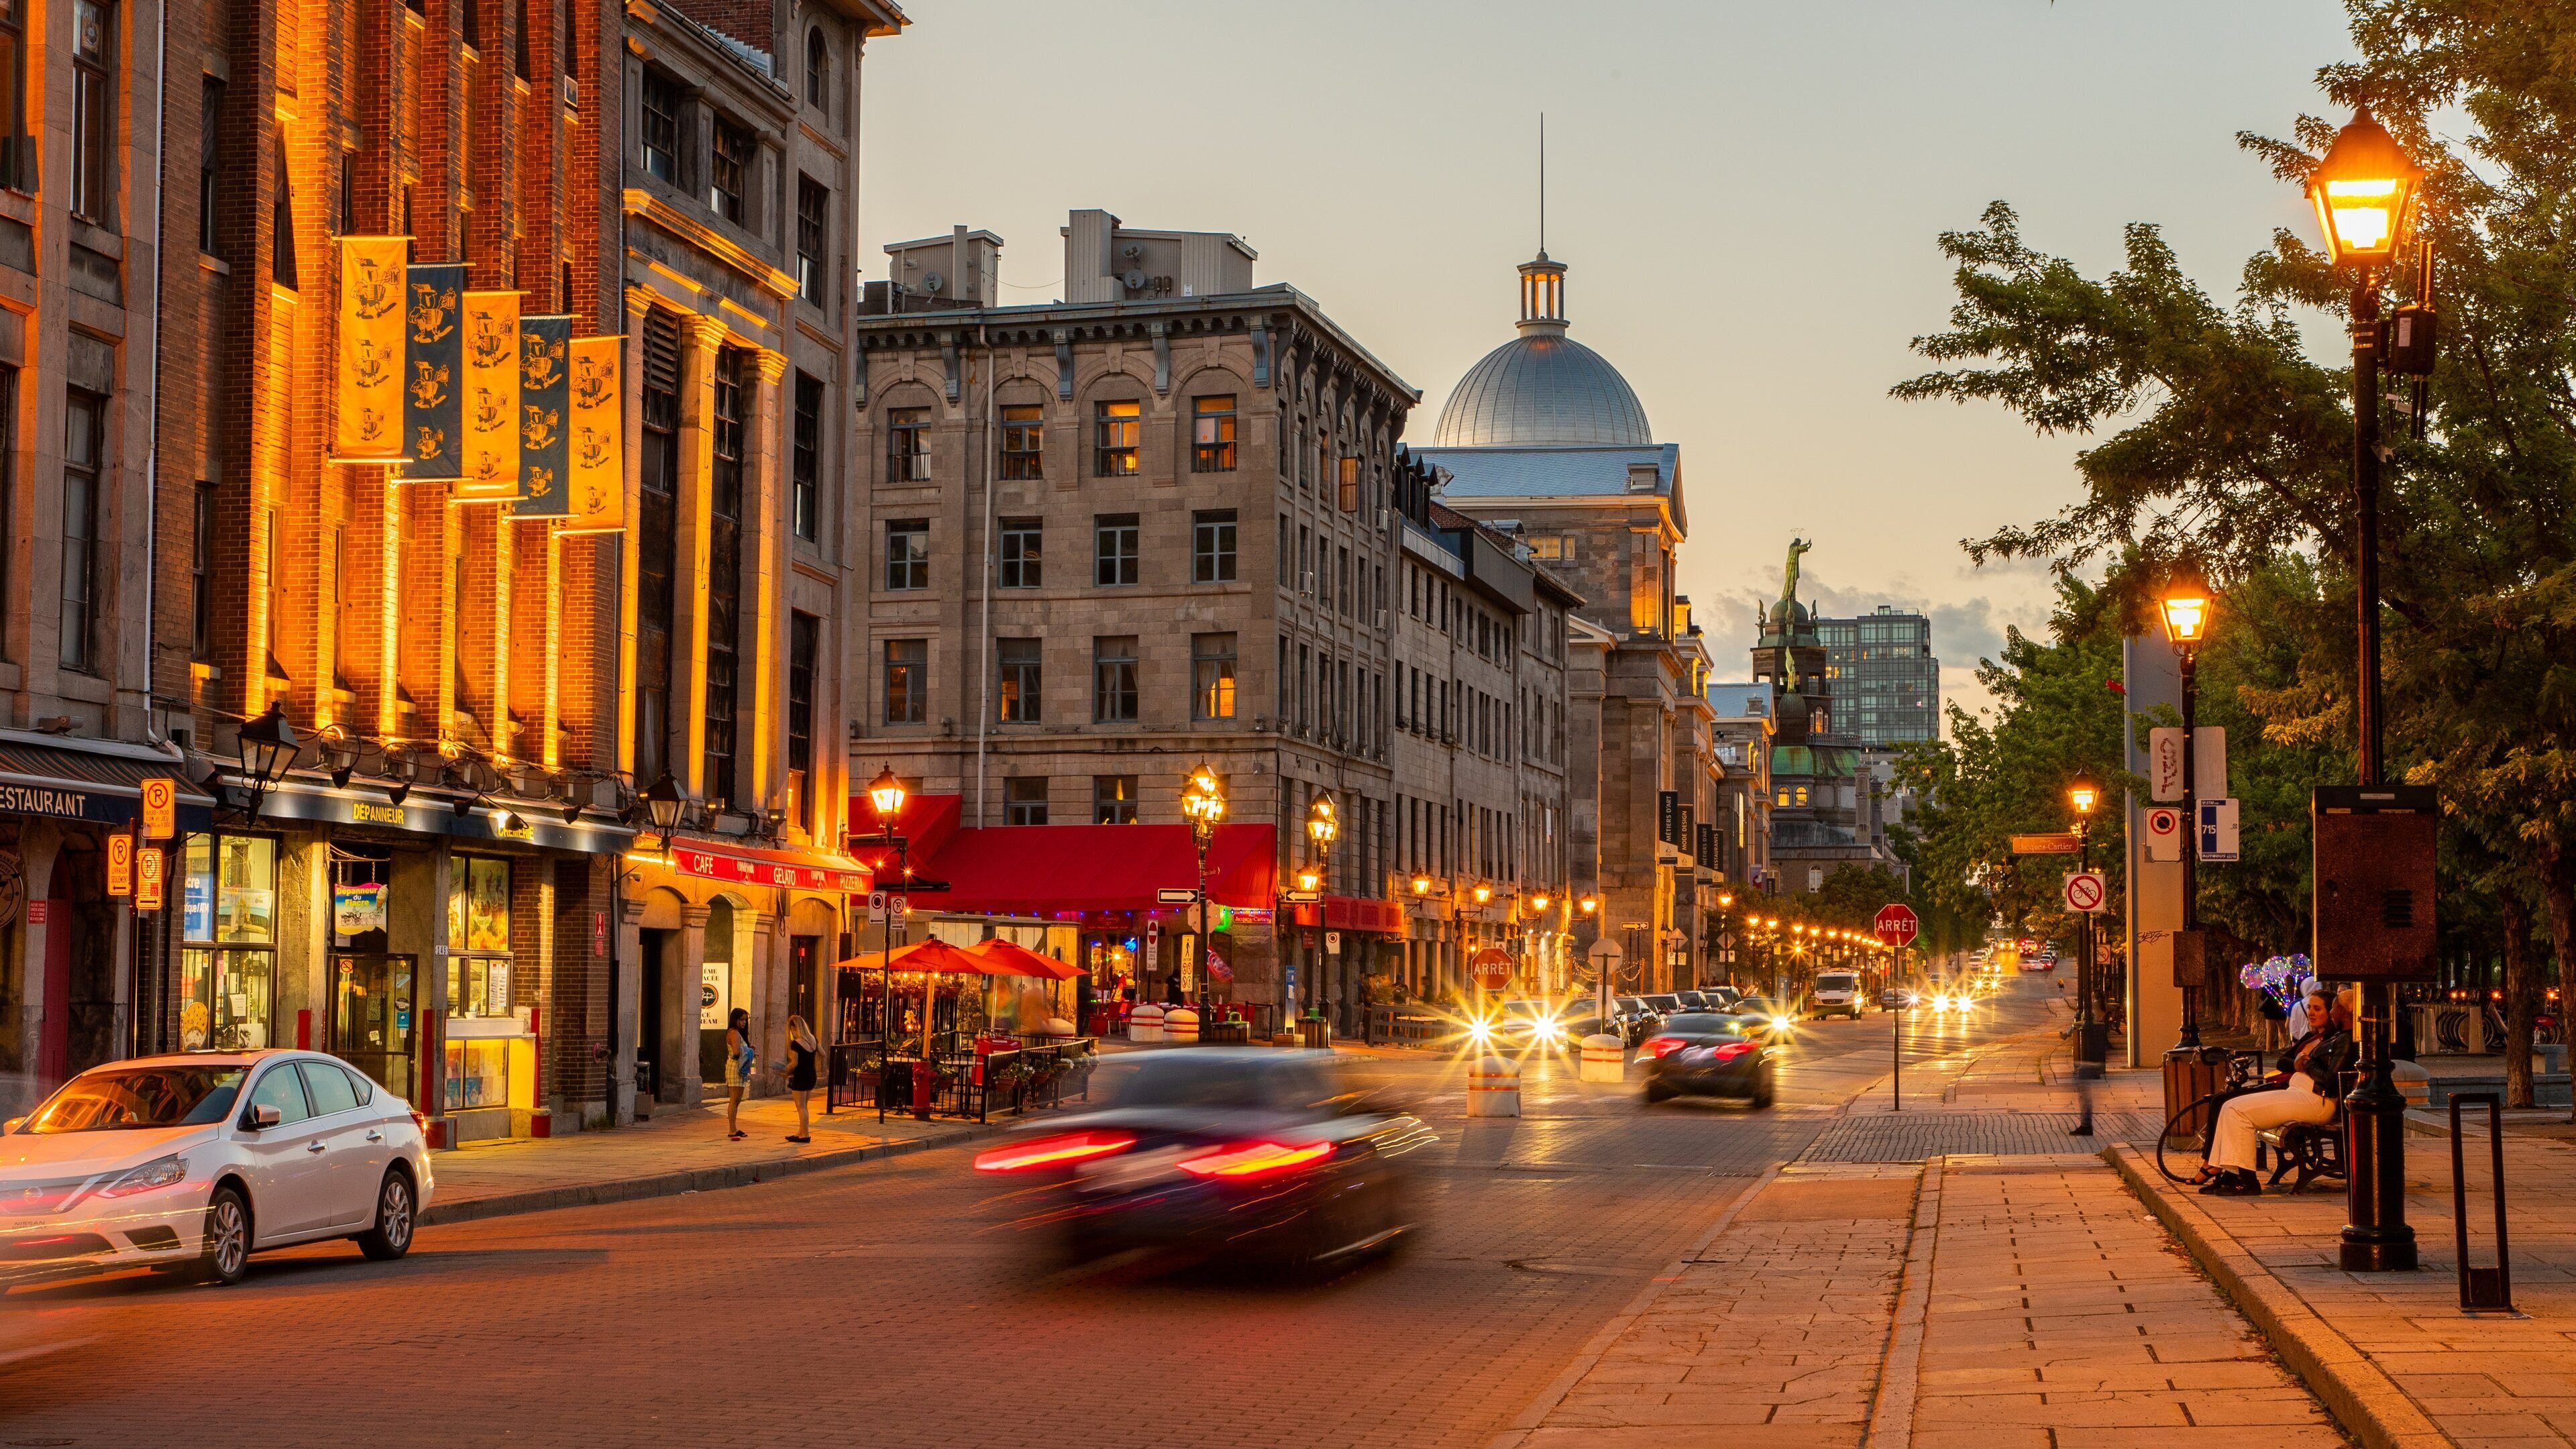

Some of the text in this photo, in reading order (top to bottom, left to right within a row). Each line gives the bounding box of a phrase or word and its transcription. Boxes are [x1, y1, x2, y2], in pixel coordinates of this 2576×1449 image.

[353, 803, 404, 824] DÉPANNEUR
[2202, 824, 2216, 835] 715
[2019, 843, 2073, 852] Jacques-Cartier
[694, 854, 713, 875] CAFÉ
[773, 867, 796, 886] GELATO
[840, 874, 863, 891] PIZZERIA
[336, 888, 378, 896] Dépanneur
[1877, 918, 1915, 932] ARRÊT
[437, 946, 446, 955] 145
[1474, 961, 1511, 975] ARRÊT
